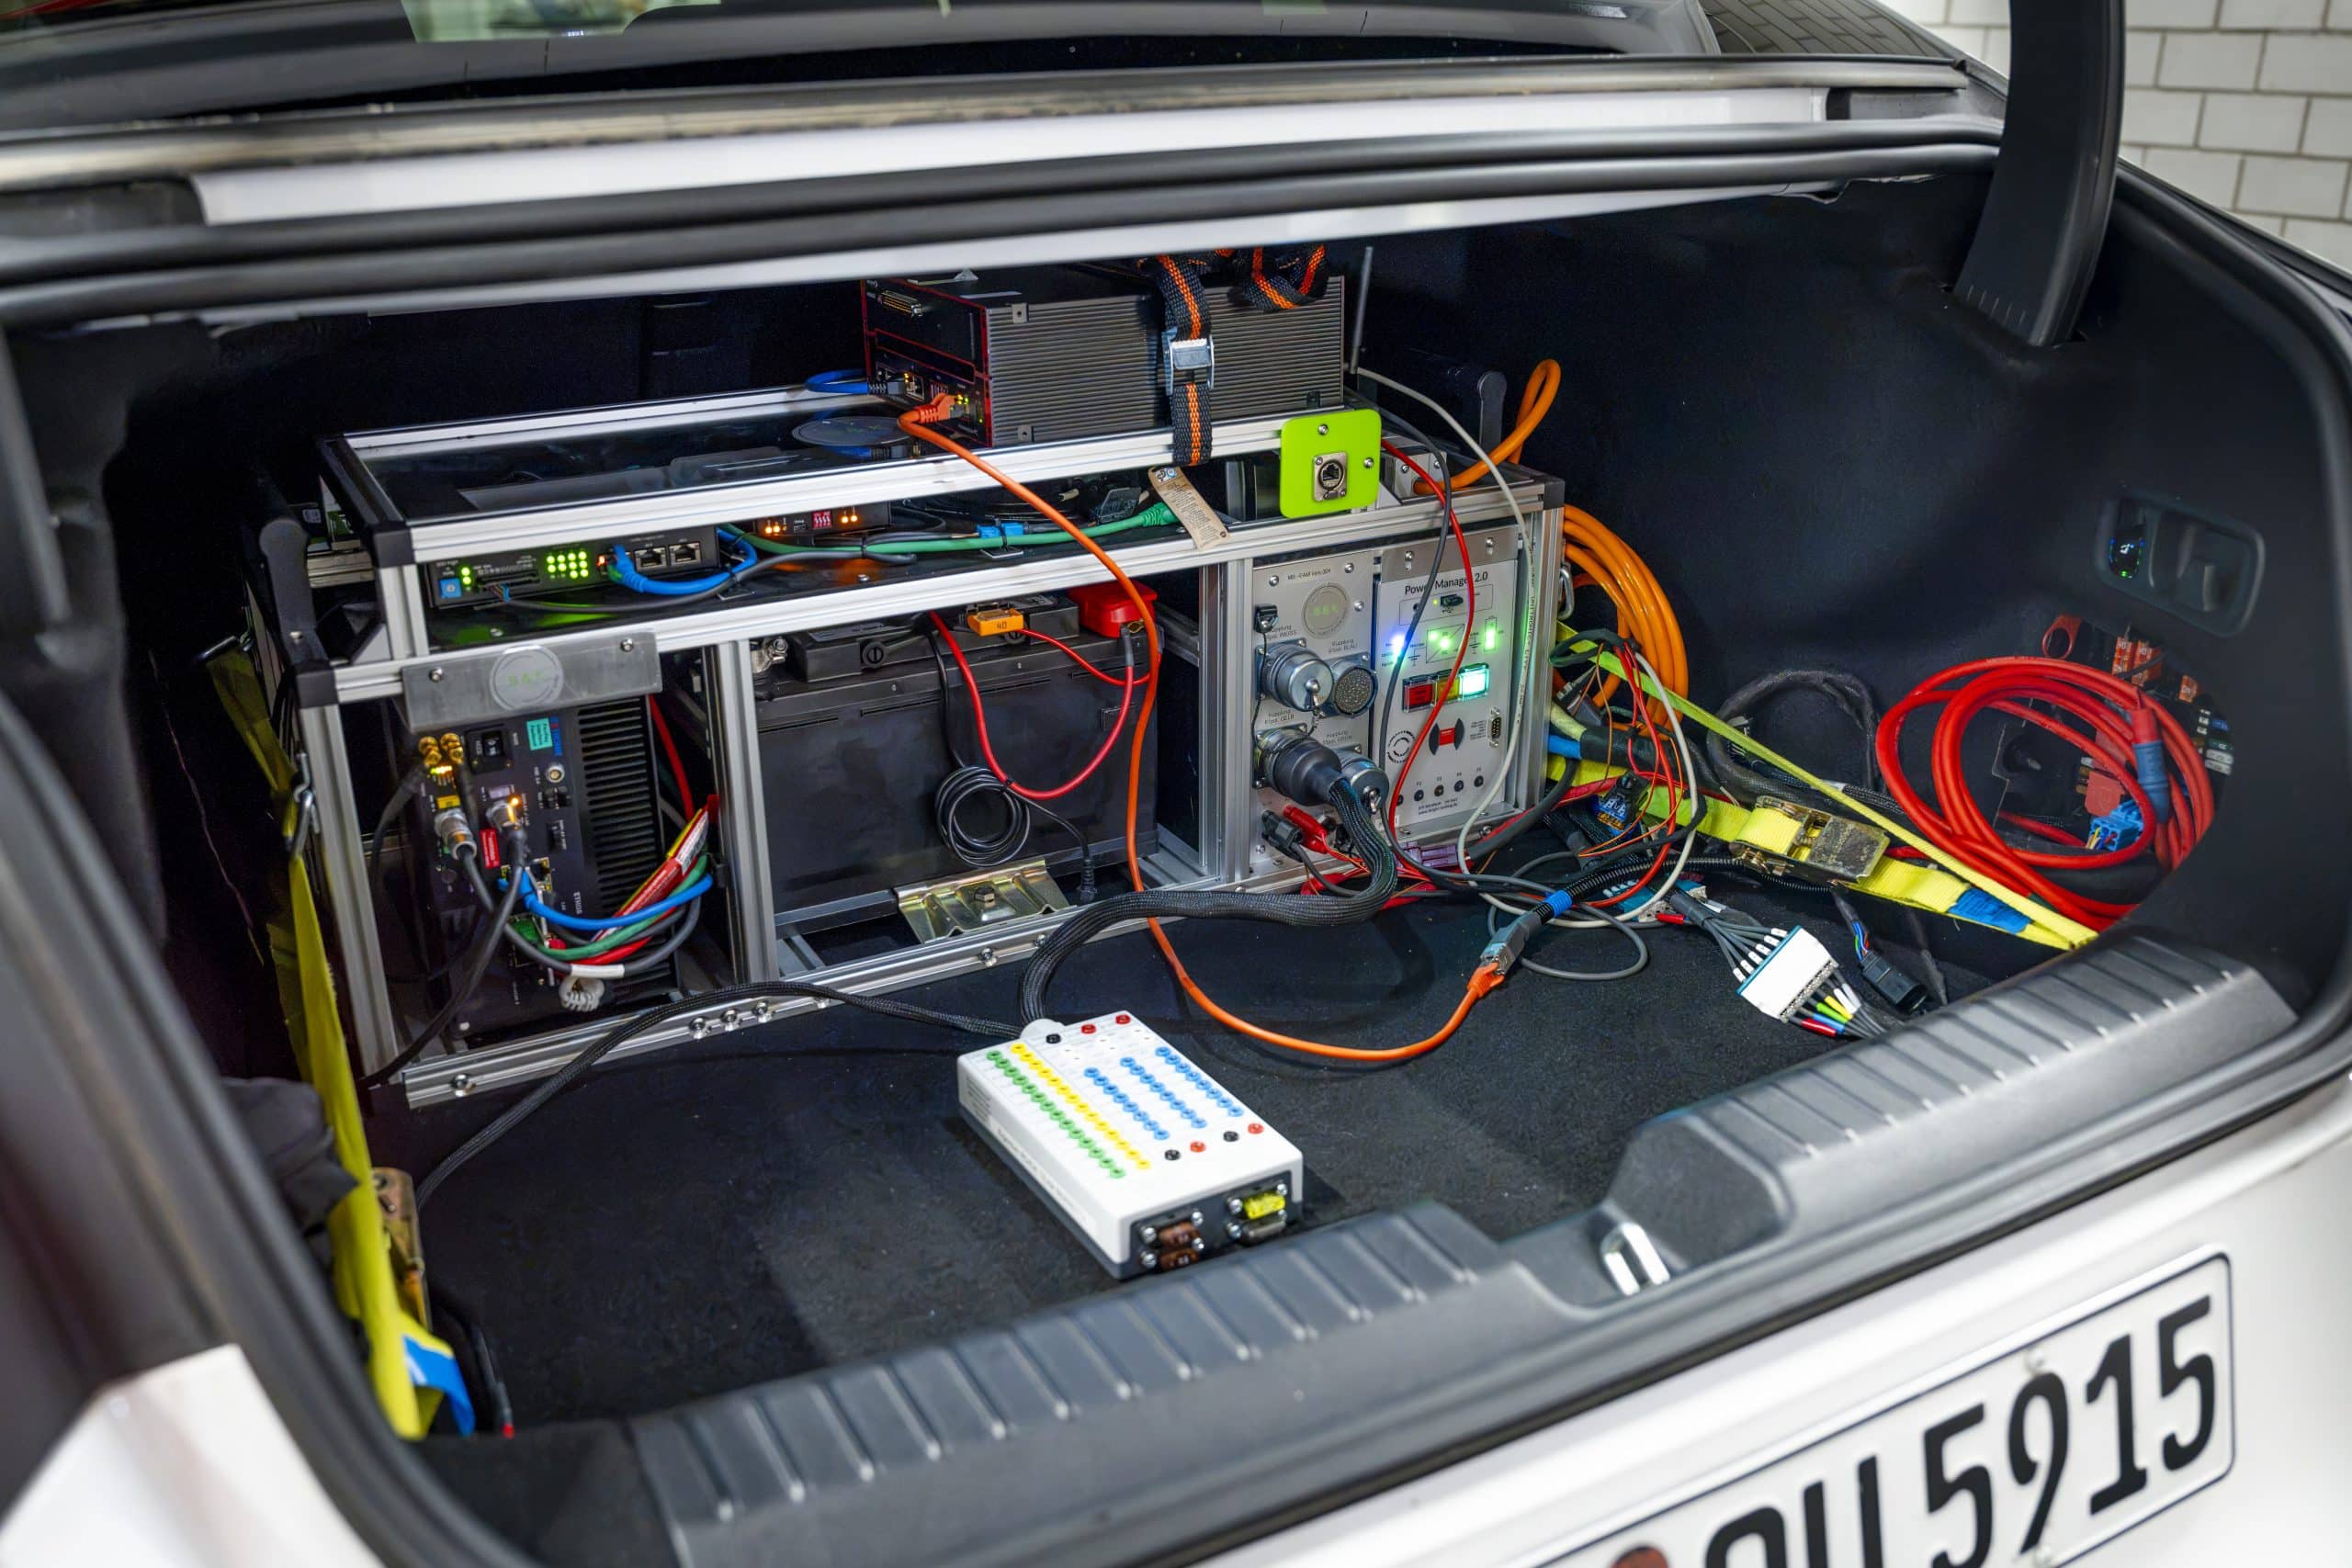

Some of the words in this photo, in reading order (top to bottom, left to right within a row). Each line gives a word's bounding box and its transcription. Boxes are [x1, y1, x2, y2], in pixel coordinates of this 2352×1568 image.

[1405, 584, 1425, 595] Pow
[1435, 577, 1468, 589] Manage
[1475, 571, 1488, 582] 2.0
[1924, 1294, 2215, 1568] 5915
